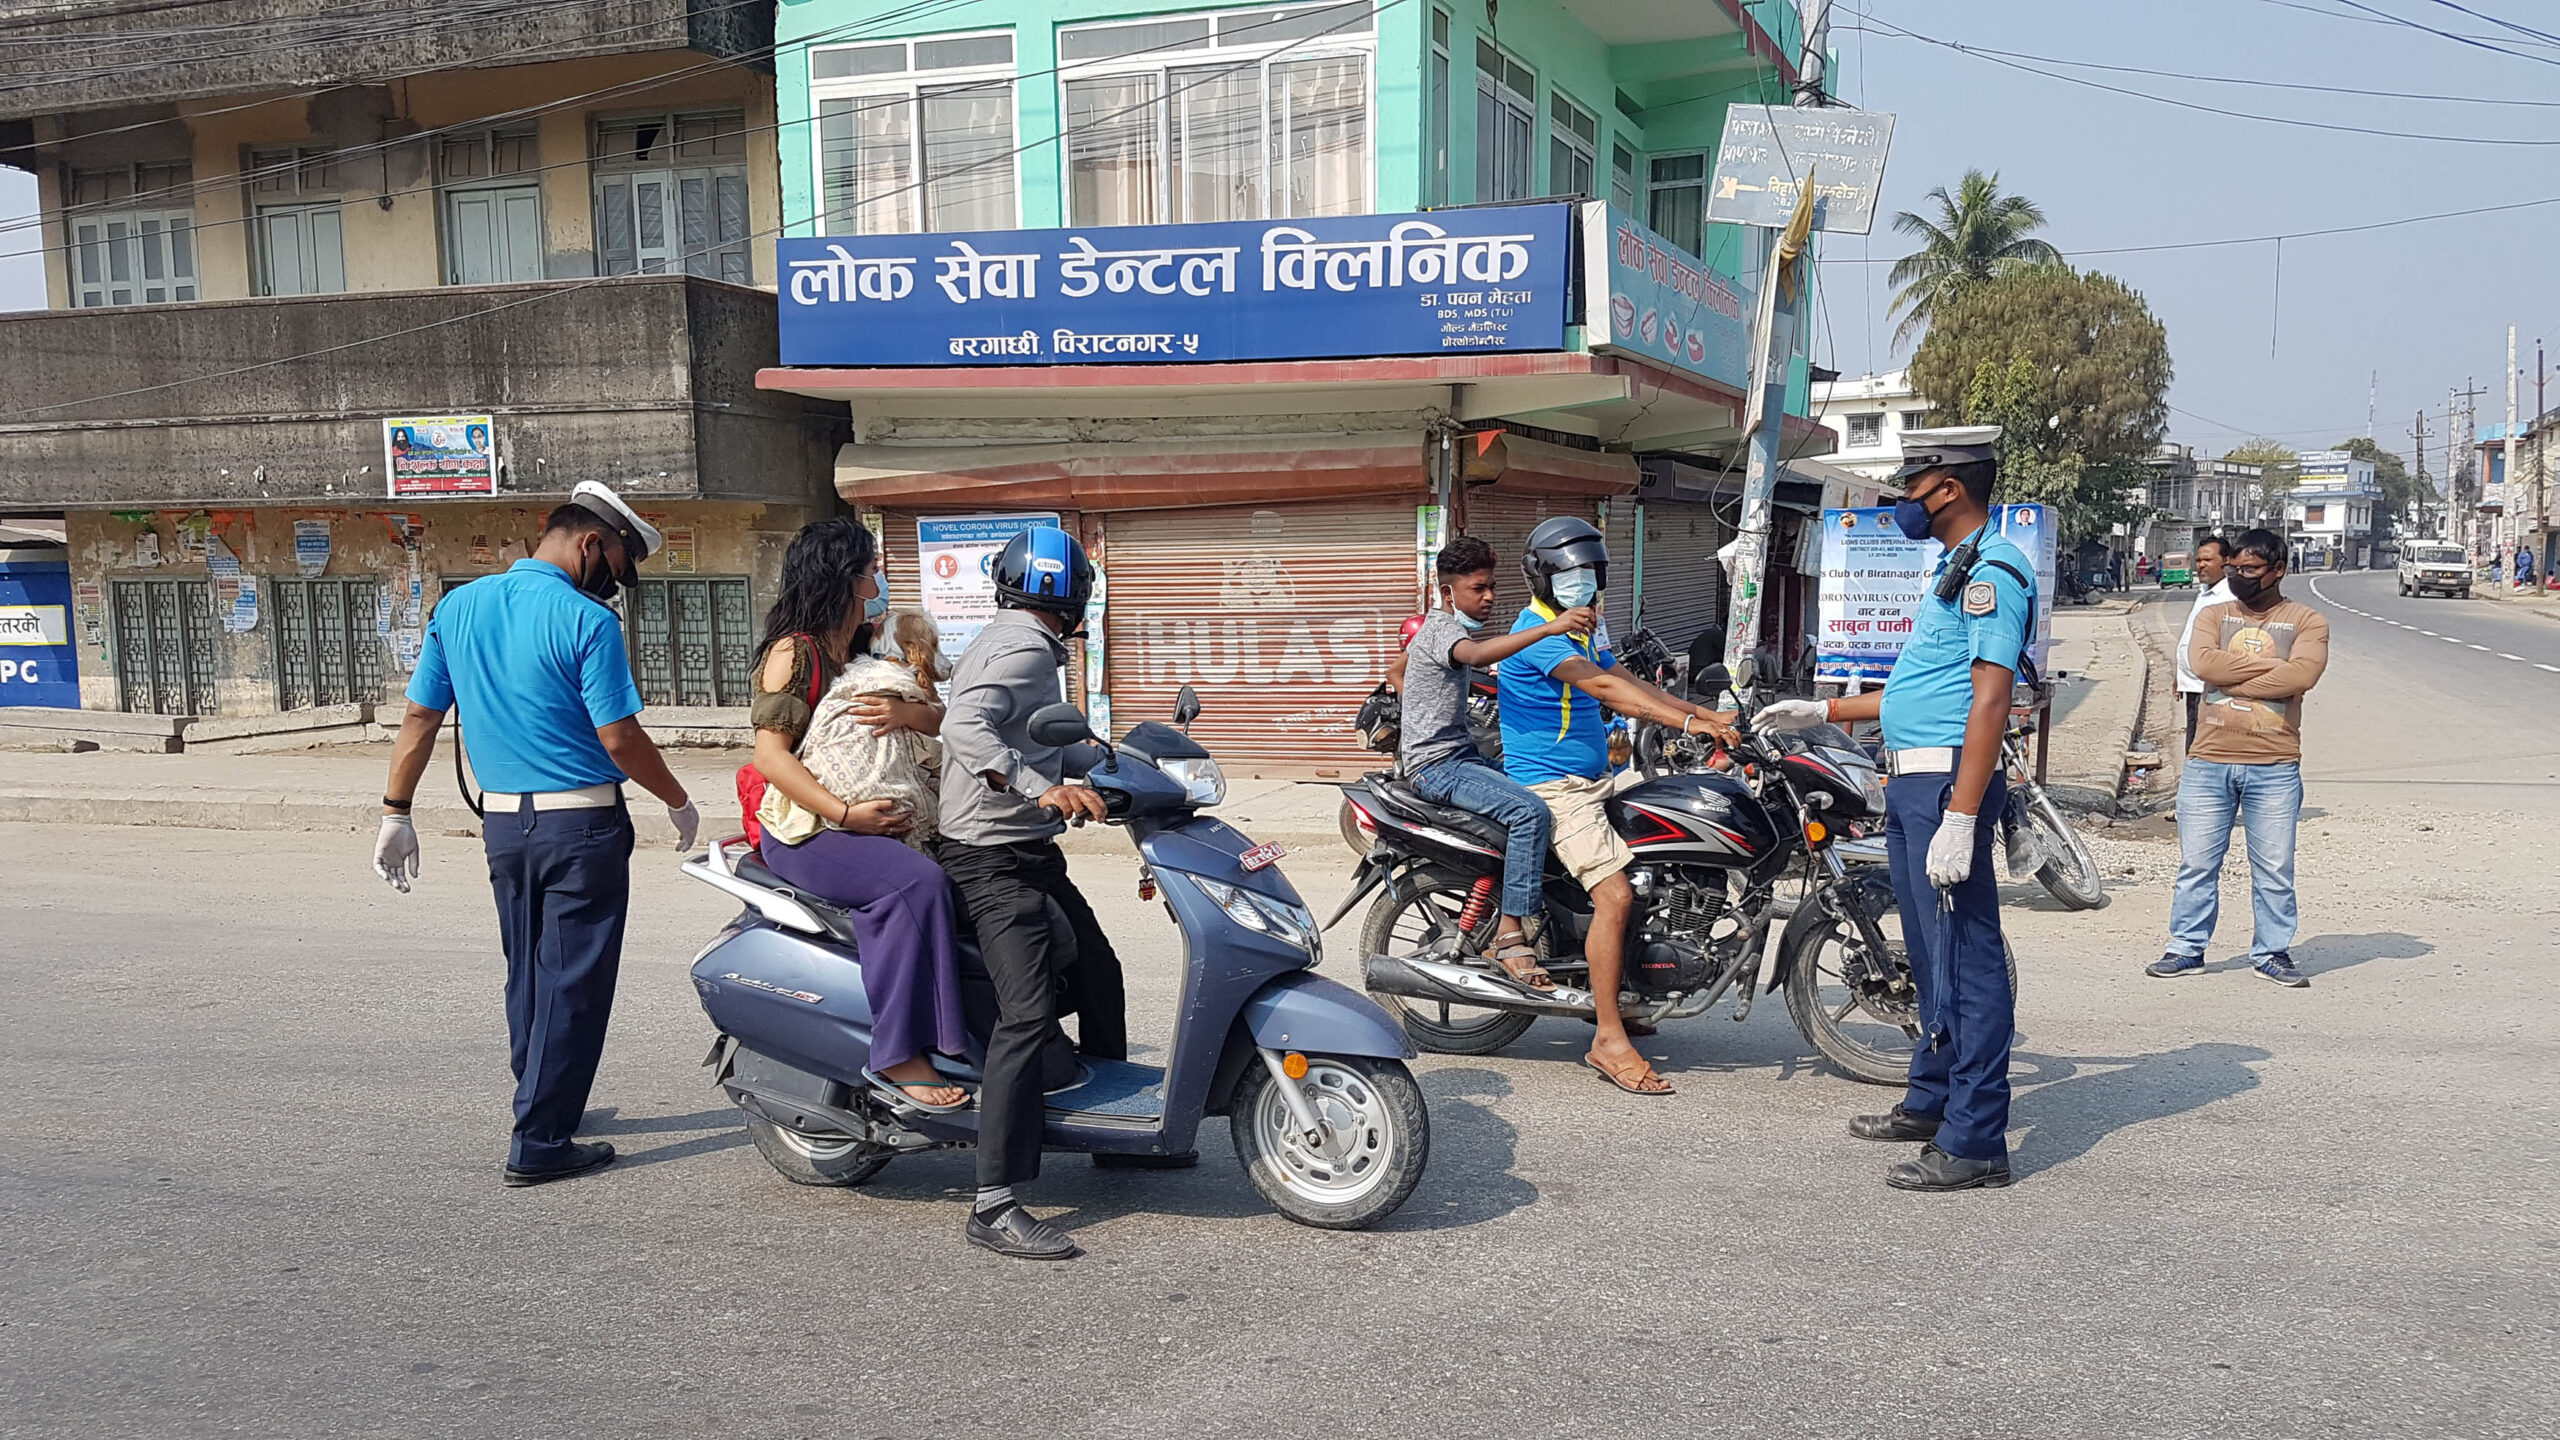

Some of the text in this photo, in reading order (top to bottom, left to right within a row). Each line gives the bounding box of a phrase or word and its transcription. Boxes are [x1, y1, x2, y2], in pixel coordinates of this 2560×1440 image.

[789, 221, 1535, 305] लोक सेवा डेन्टल क्लिनिक
[1617, 218, 1740, 322] लोक सेवा डेन्टल क्लिनिक
[1420, 287, 1532, 307] डा. पवन मेहता
[1437, 307, 1514, 319] BDS, MDS (TU)
[933, 524, 959, 532] NOVEL
[961, 522, 994, 531] CORONA
[996, 521, 1019, 530] VIRUS
[1829, 569, 1851, 578] Club
[1854, 569, 1865, 578] of
[1868, 569, 1921, 579] Biratnagar
[1858, 608, 1876, 616] बाट
[1828, 616, 1913, 635] साबुन पानी
[1149, 618, 1371, 684] HULAS
[1848, 641, 1873, 649] पटक
[1874, 642, 1892, 650] हात
